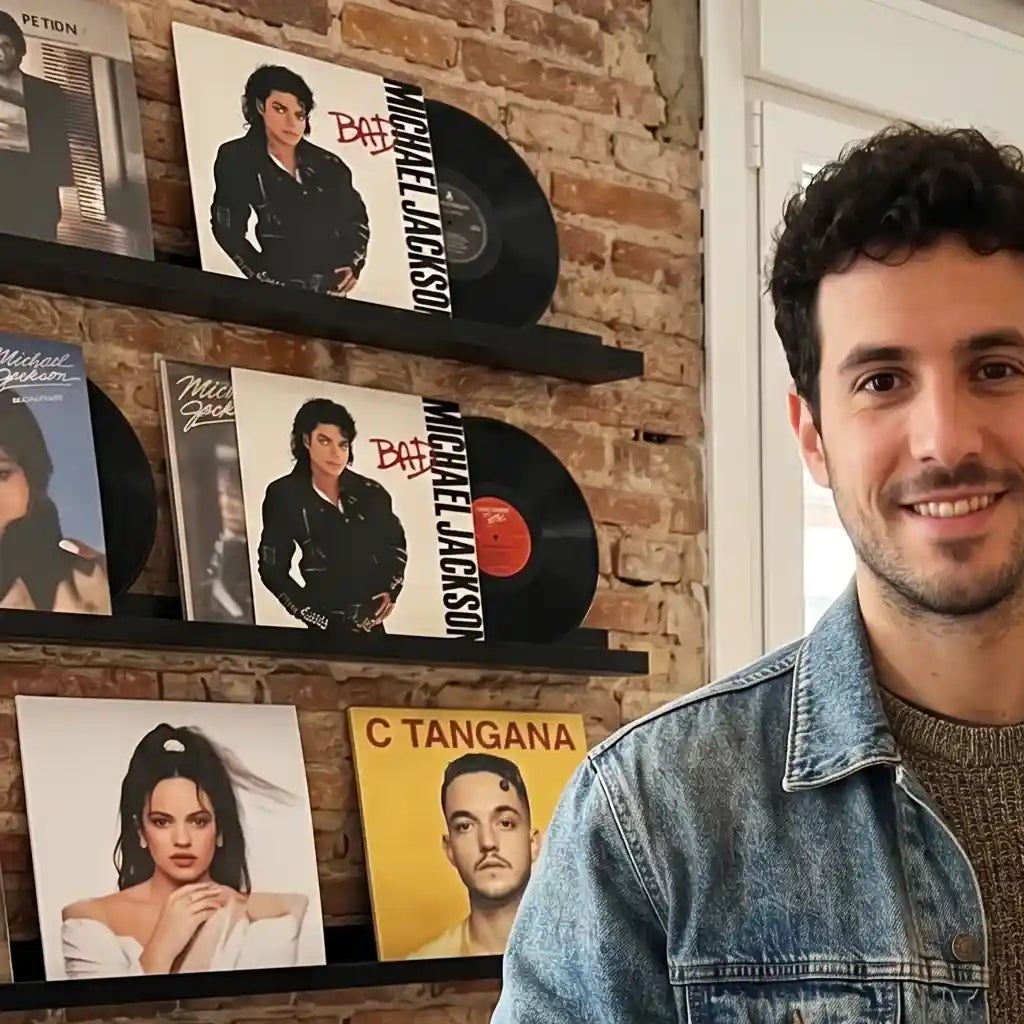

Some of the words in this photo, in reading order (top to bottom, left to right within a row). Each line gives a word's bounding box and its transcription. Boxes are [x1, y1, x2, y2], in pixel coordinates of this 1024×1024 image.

[328, 111, 398, 155] BAD
[383, 78, 438, 196] MICHAEL
[401, 199, 451, 312] JACKSO
[369, 436, 437, 480] BAD
[422, 397, 473, 518] MICHAEL
[366, 717, 392, 749] C
[401, 718, 577, 751] TANGANA
